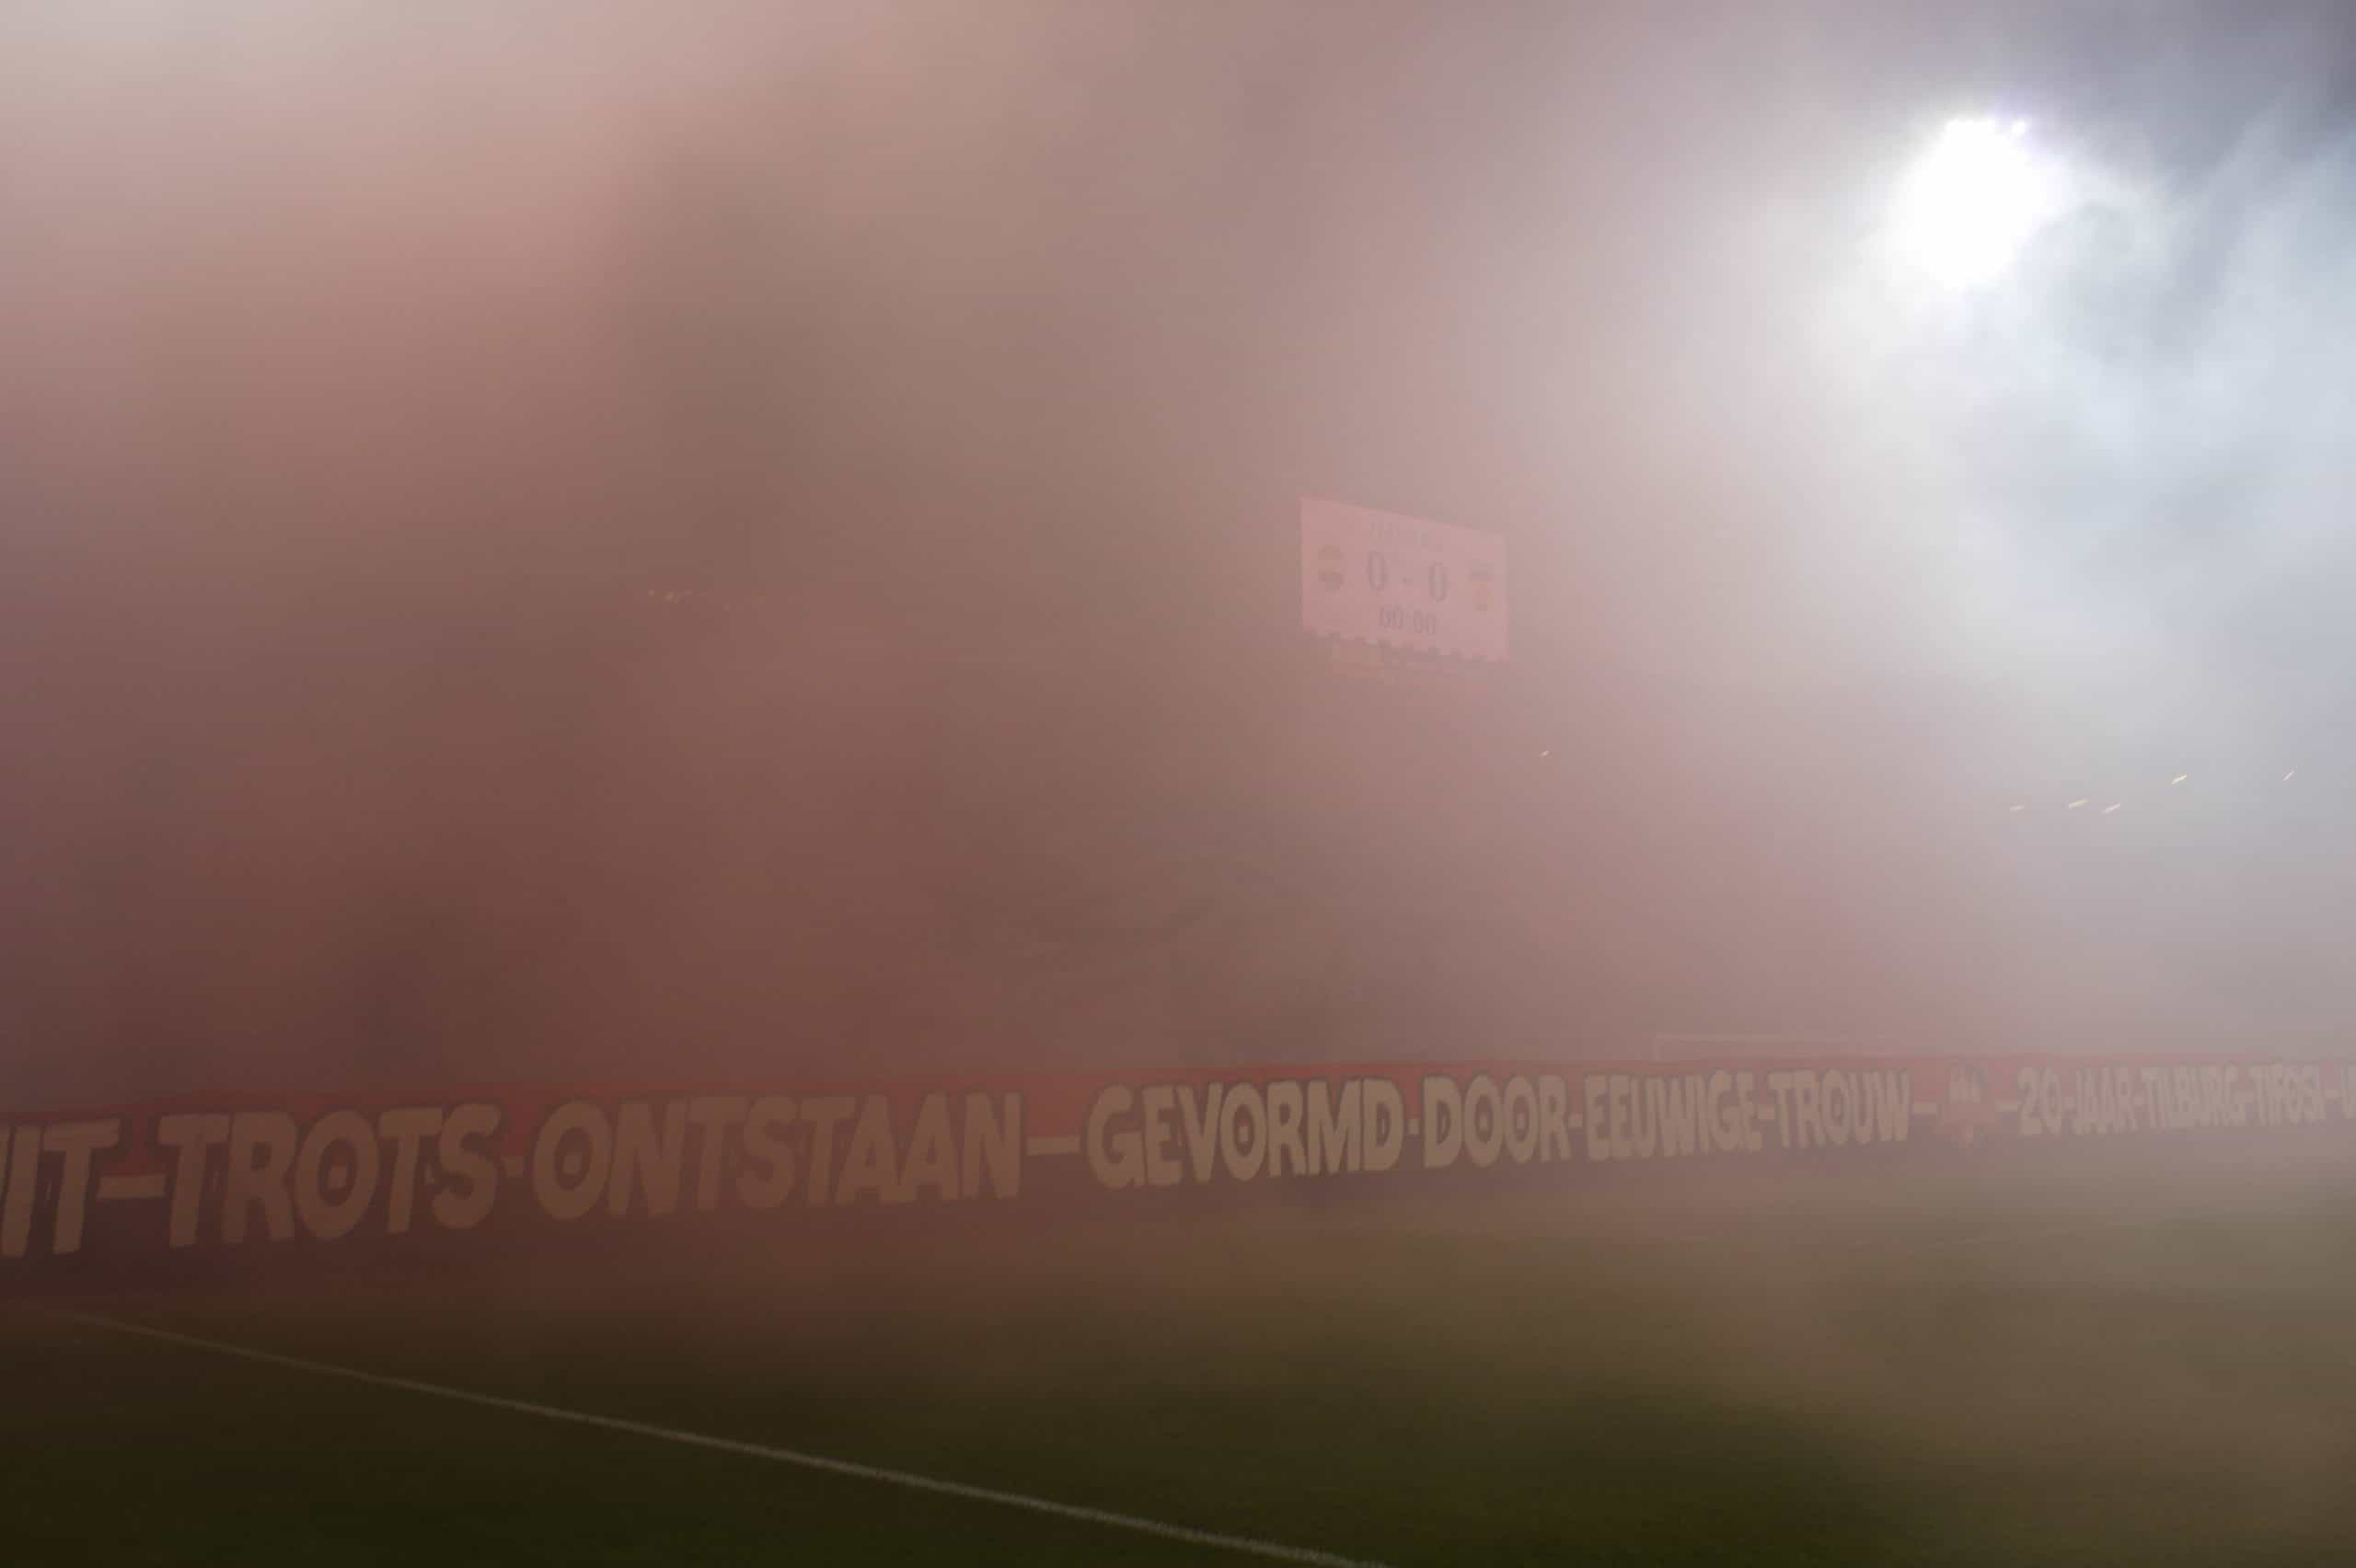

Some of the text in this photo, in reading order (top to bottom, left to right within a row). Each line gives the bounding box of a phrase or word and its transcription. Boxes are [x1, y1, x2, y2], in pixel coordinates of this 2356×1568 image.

[1368, 551, 1387, 592] 0
[1428, 560, 1449, 603] 0
[0, 1118, 121, 1257] IT
[158, 1103, 501, 1250] TROTS
[534, 1092, 1022, 1220] ONTSTAAN
[1088, 1078, 1404, 1187] GEVORMD
[1424, 1075, 1571, 1169] DOOR
[1584, 1069, 1763, 1161] EEUWIGE
[1767, 1068, 1910, 1149] TROUW
[2017, 1066, 2062, 1135] 20
